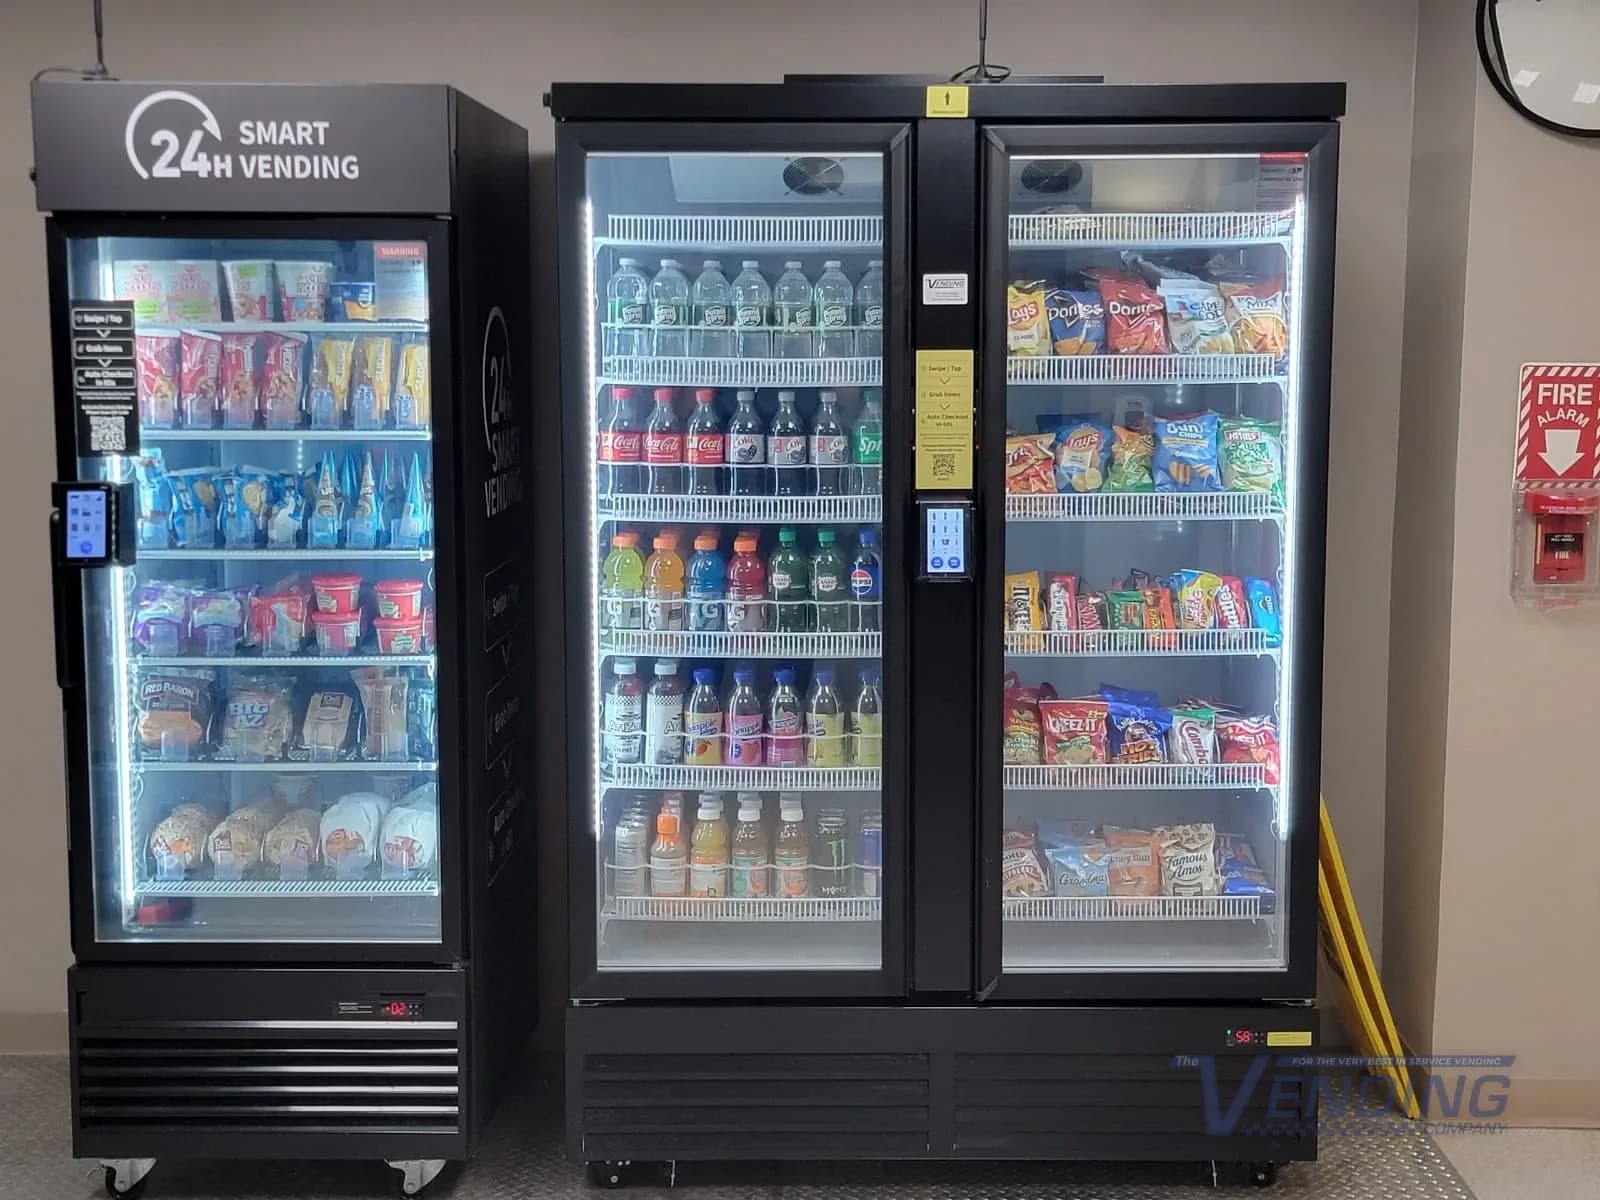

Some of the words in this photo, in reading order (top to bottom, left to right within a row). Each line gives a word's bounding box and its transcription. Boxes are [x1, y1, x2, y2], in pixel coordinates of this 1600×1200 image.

[239, 120, 330, 145] SMART
[151, 129, 232, 178] 24H
[239, 155, 360, 179] VENDING
[1046, 303, 1104, 321] Doritos
[1537, 383, 1594, 405] FIRE
[1537, 408, 1590, 427] ALARM
[702, 601, 719, 619] G
[163, 682, 194, 699] BARON
[229, 702, 270, 716] BIG
[1167, 852, 1208, 869] Famous
[1168, 864, 1206, 881] Amos
